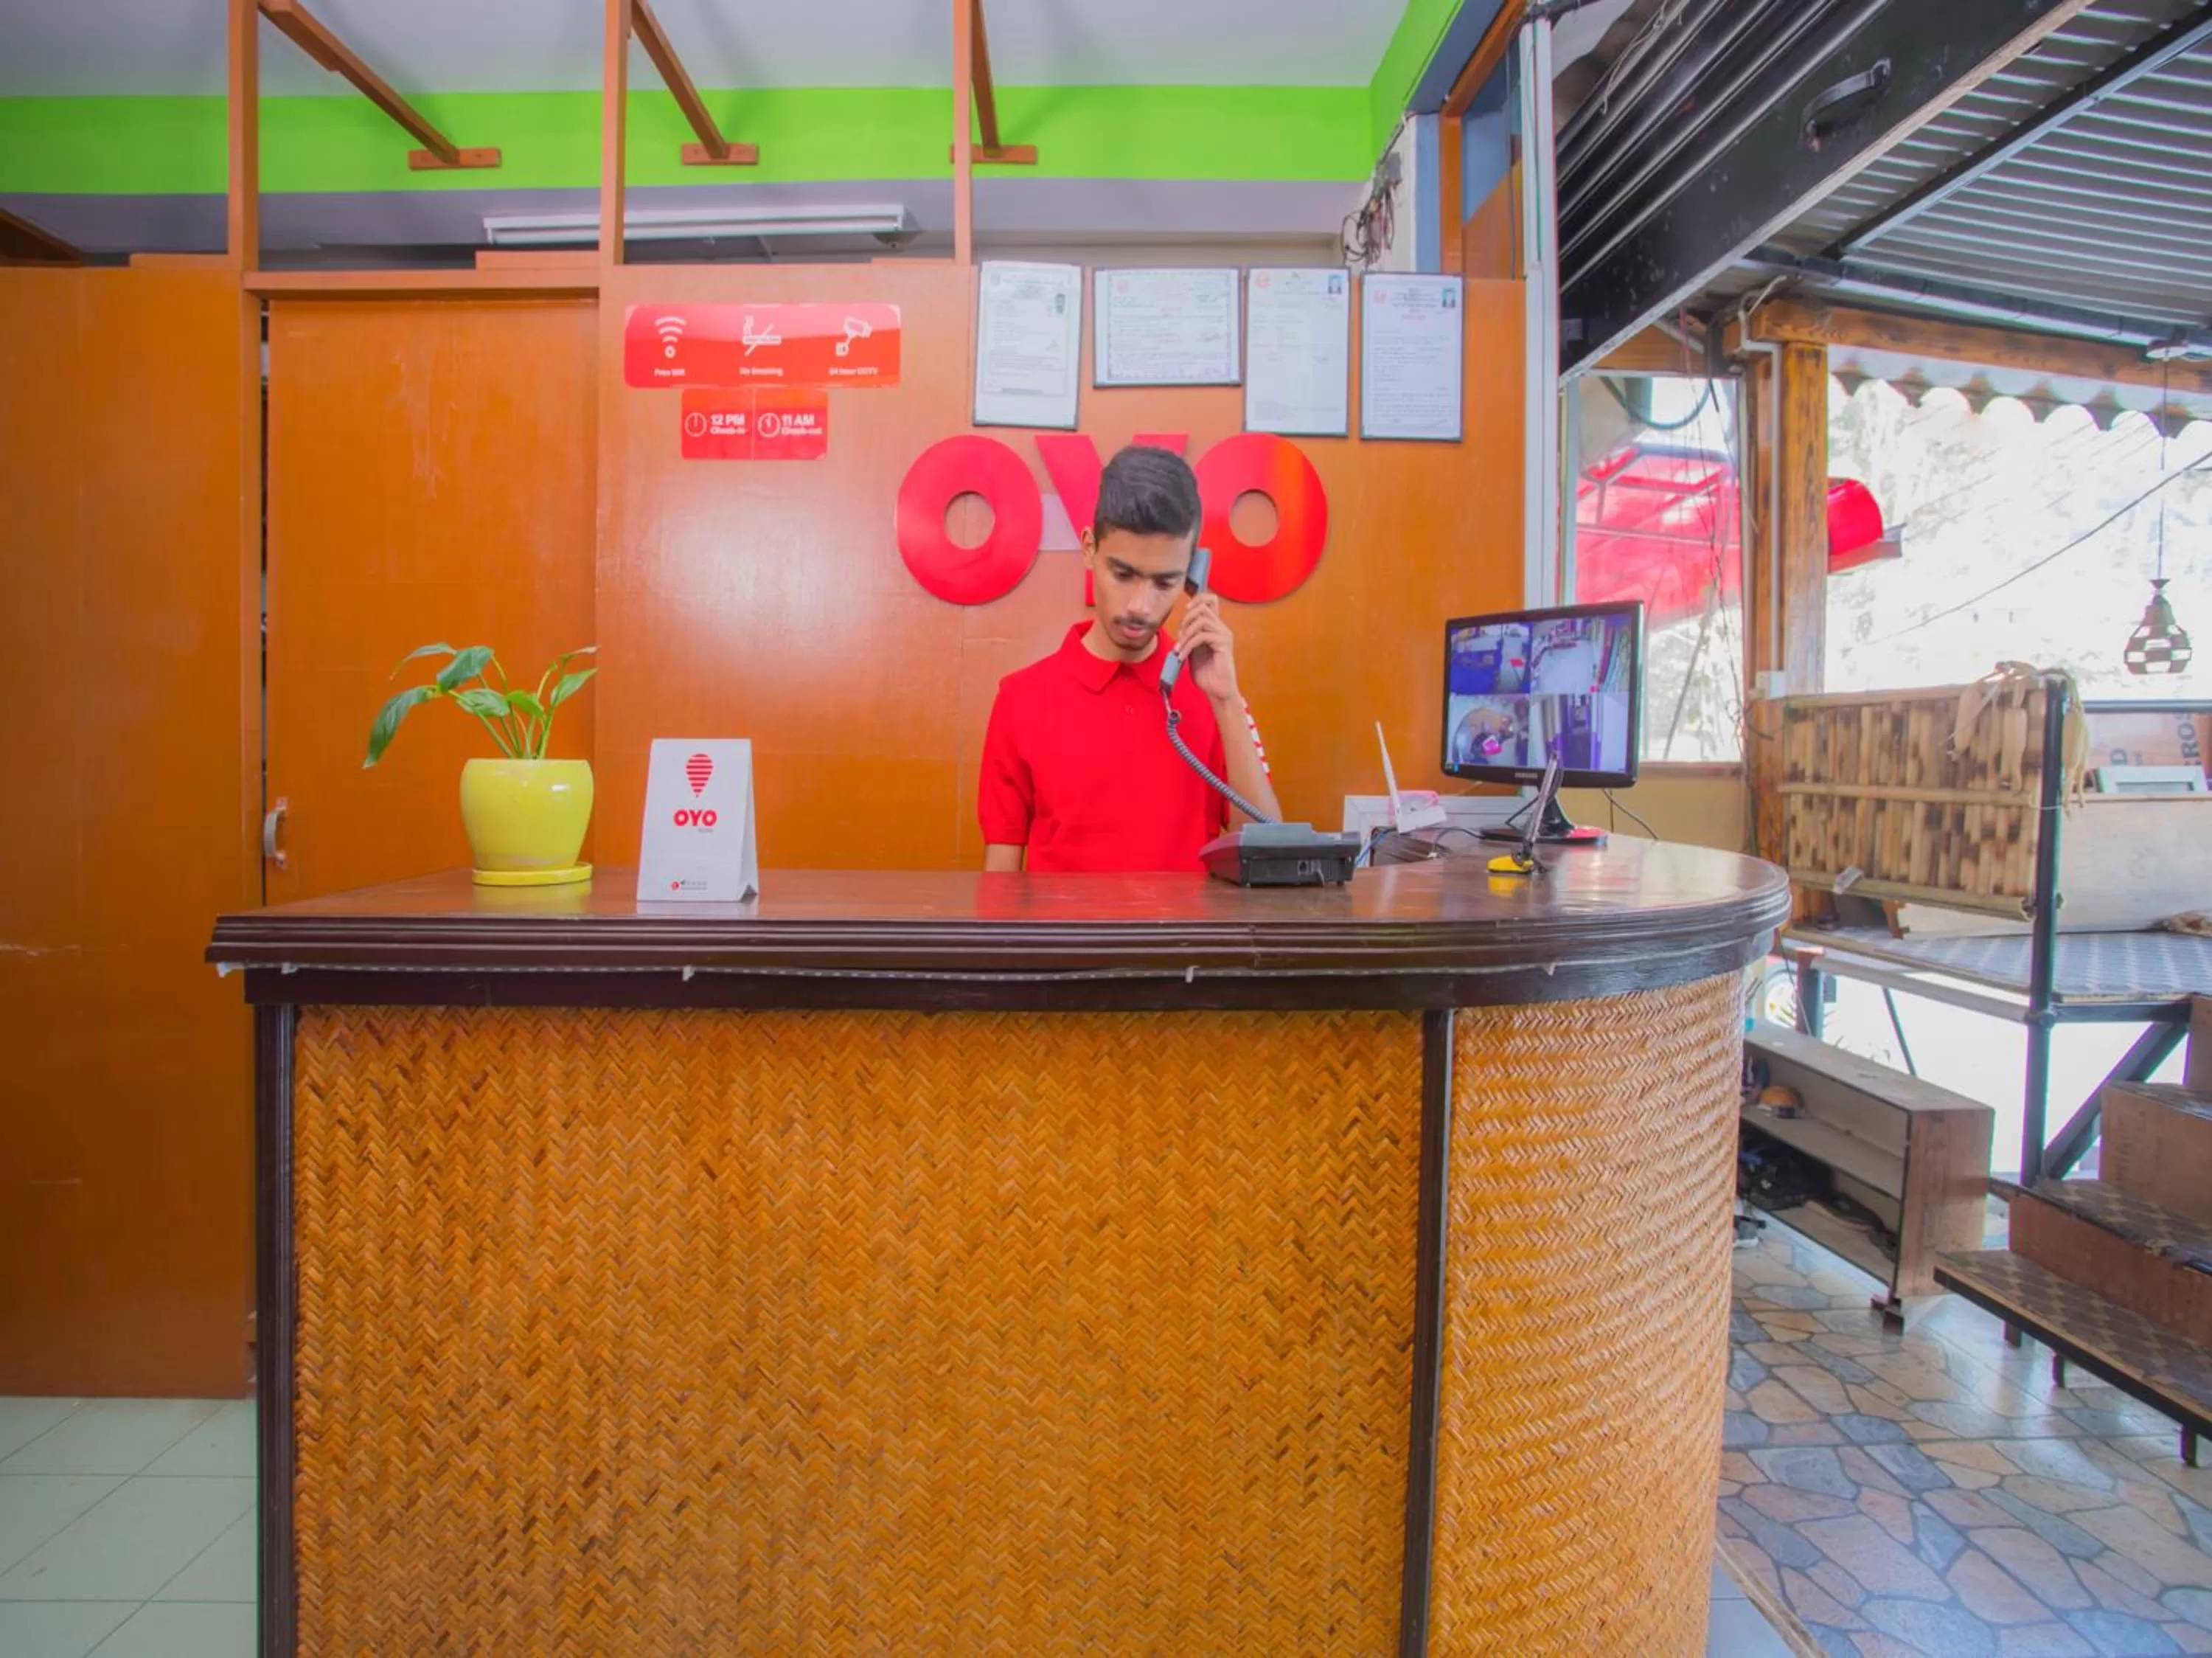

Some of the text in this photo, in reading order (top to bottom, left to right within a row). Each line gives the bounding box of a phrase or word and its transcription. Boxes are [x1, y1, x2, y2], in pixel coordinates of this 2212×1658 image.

[710, 414, 745, 426] 12 PM
[782, 414, 815, 426] 11 AM
[673, 809, 717, 827] OYO
